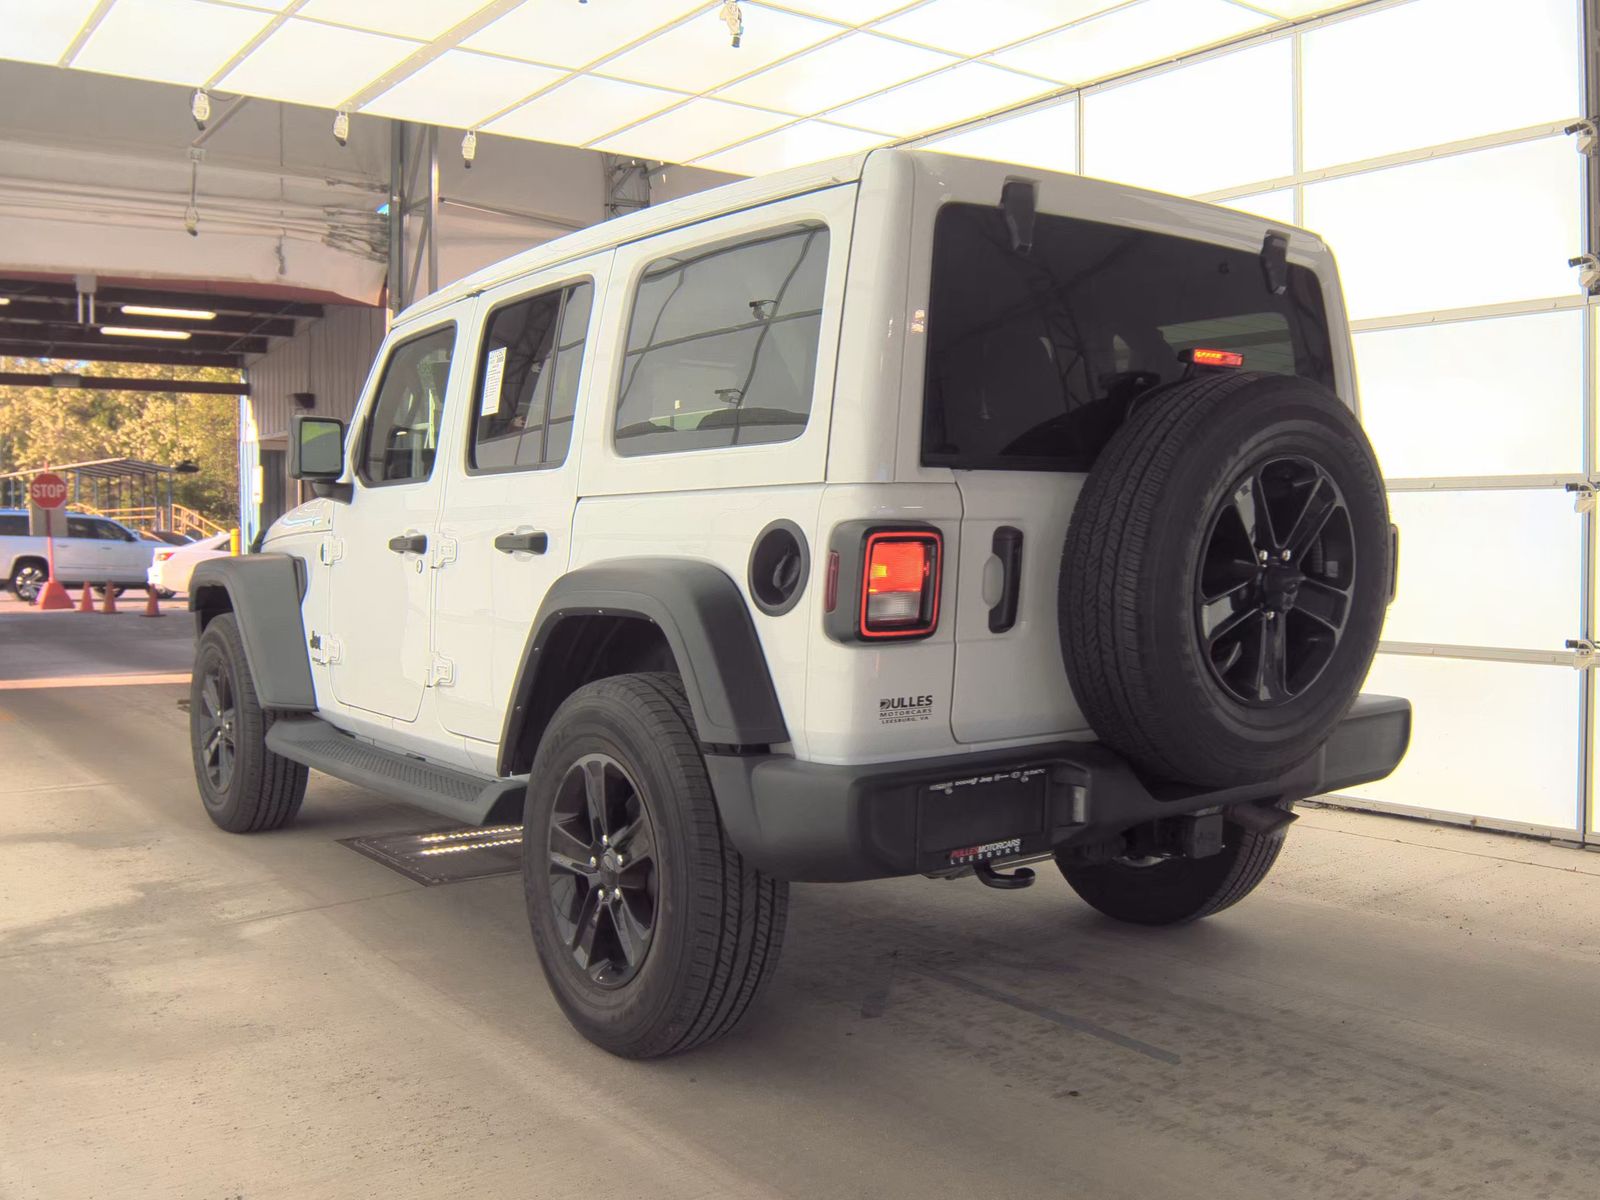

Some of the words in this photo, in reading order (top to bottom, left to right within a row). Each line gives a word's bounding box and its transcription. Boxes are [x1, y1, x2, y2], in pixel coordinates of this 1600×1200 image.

[32, 483, 65, 498] STOP
[879, 694, 933, 709] DULLES
[879, 708, 932, 717] MOTORCARS
[950, 845, 1020, 865] LEESBURG
